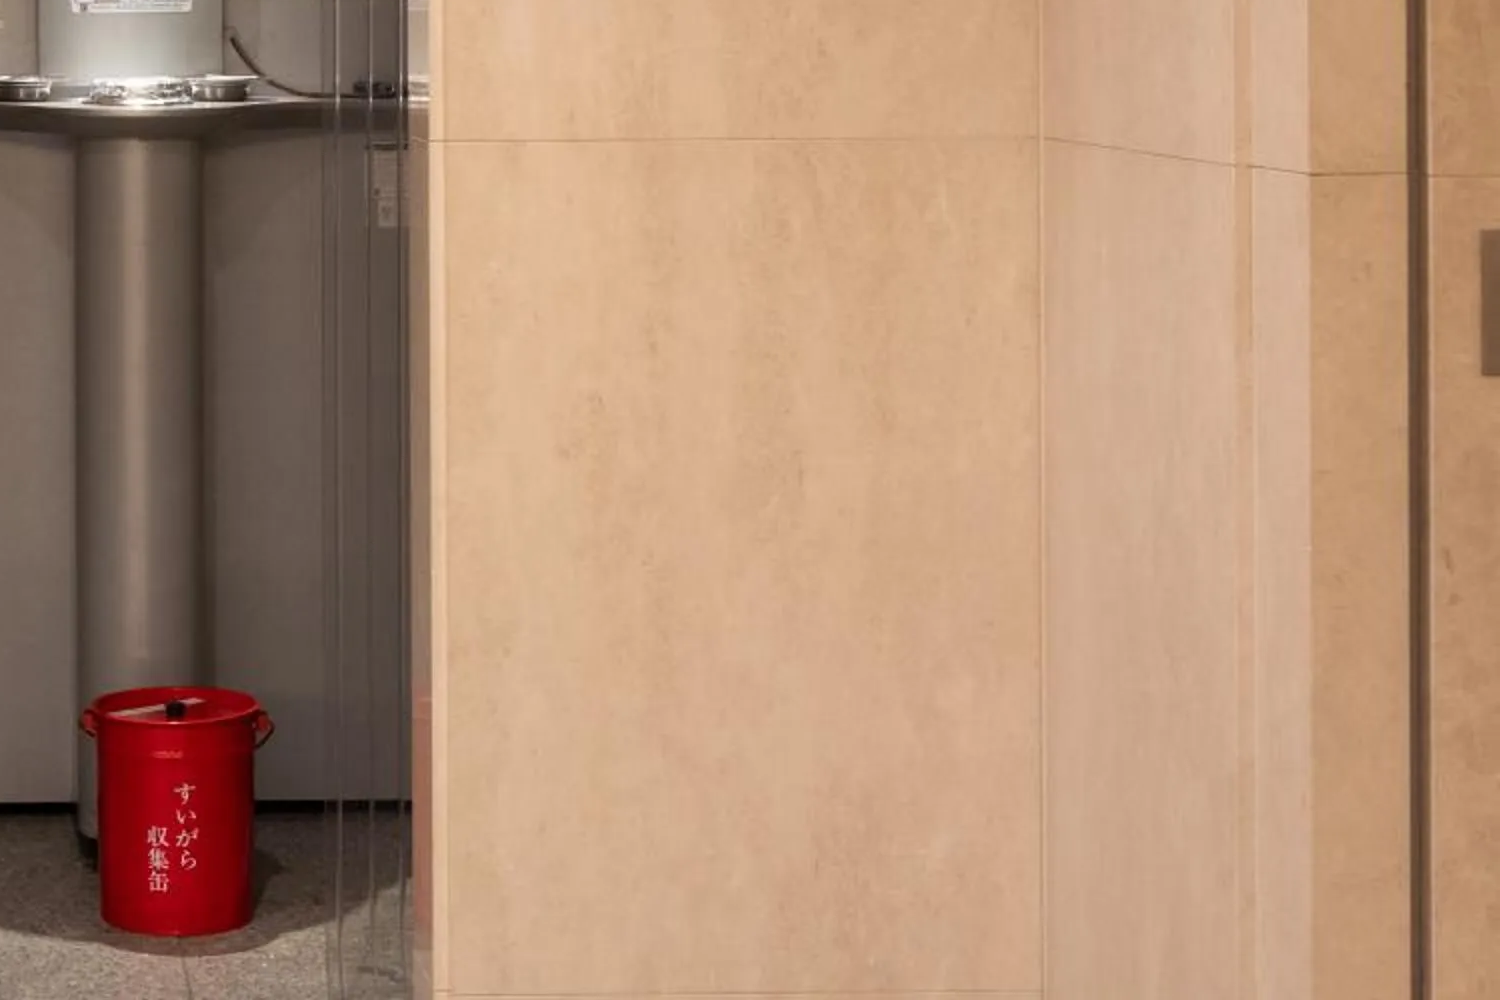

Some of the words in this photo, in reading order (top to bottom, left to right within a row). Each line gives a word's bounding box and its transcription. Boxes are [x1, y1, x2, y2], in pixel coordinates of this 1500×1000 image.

[147, 825, 170, 893] 収集缶
[173, 782, 198, 871] すいがら
